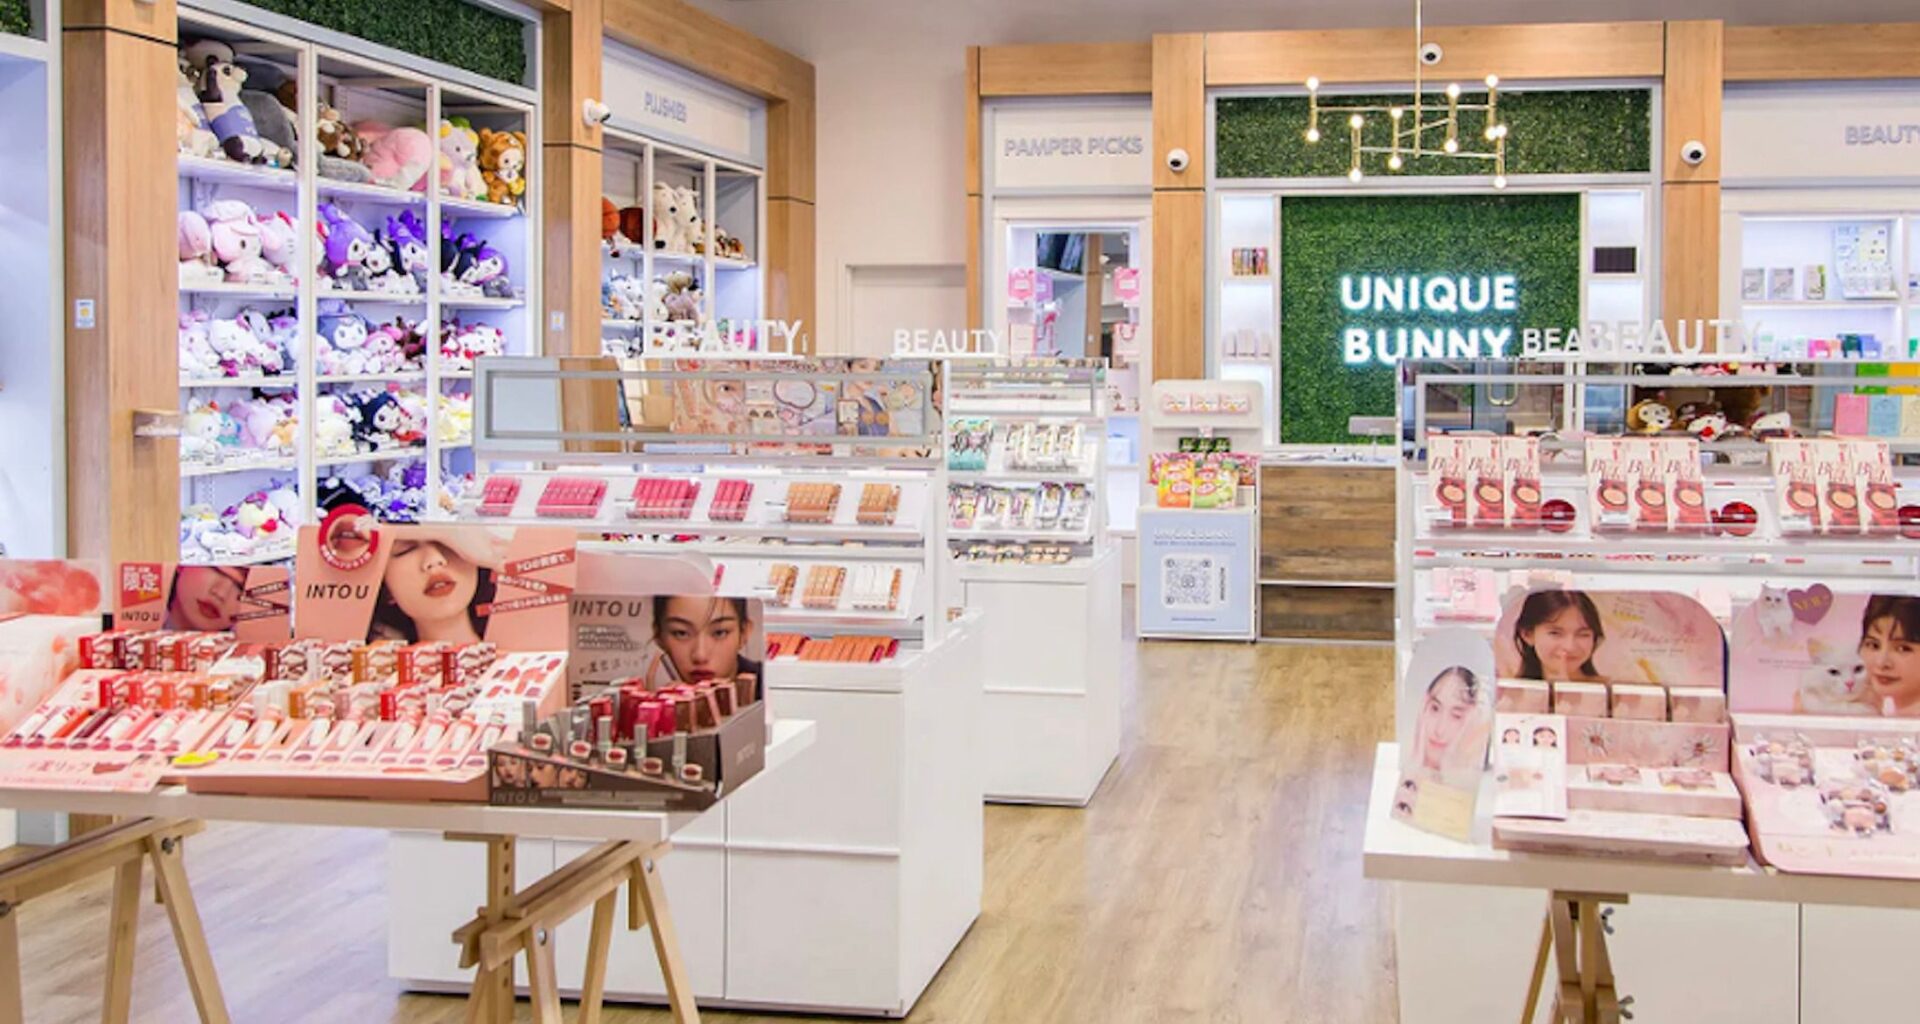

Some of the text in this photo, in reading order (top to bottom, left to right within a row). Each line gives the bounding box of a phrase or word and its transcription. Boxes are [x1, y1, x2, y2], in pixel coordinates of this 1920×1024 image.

[644, 91, 688, 123] PLUSHIES
[1004, 136, 1143, 157] PAMPER PICKS
[1341, 275, 1517, 312] UNIQUE
[646, 319, 802, 354] BEAUTY
[894, 329, 1003, 353] BEAUTY
[1344, 326, 1512, 365] BUNNY
[1588, 320, 1763, 355] BEAUTY
[306, 584, 370, 599] INTO U
[572, 600, 623, 617] INTO
[628, 600, 642, 617] U
